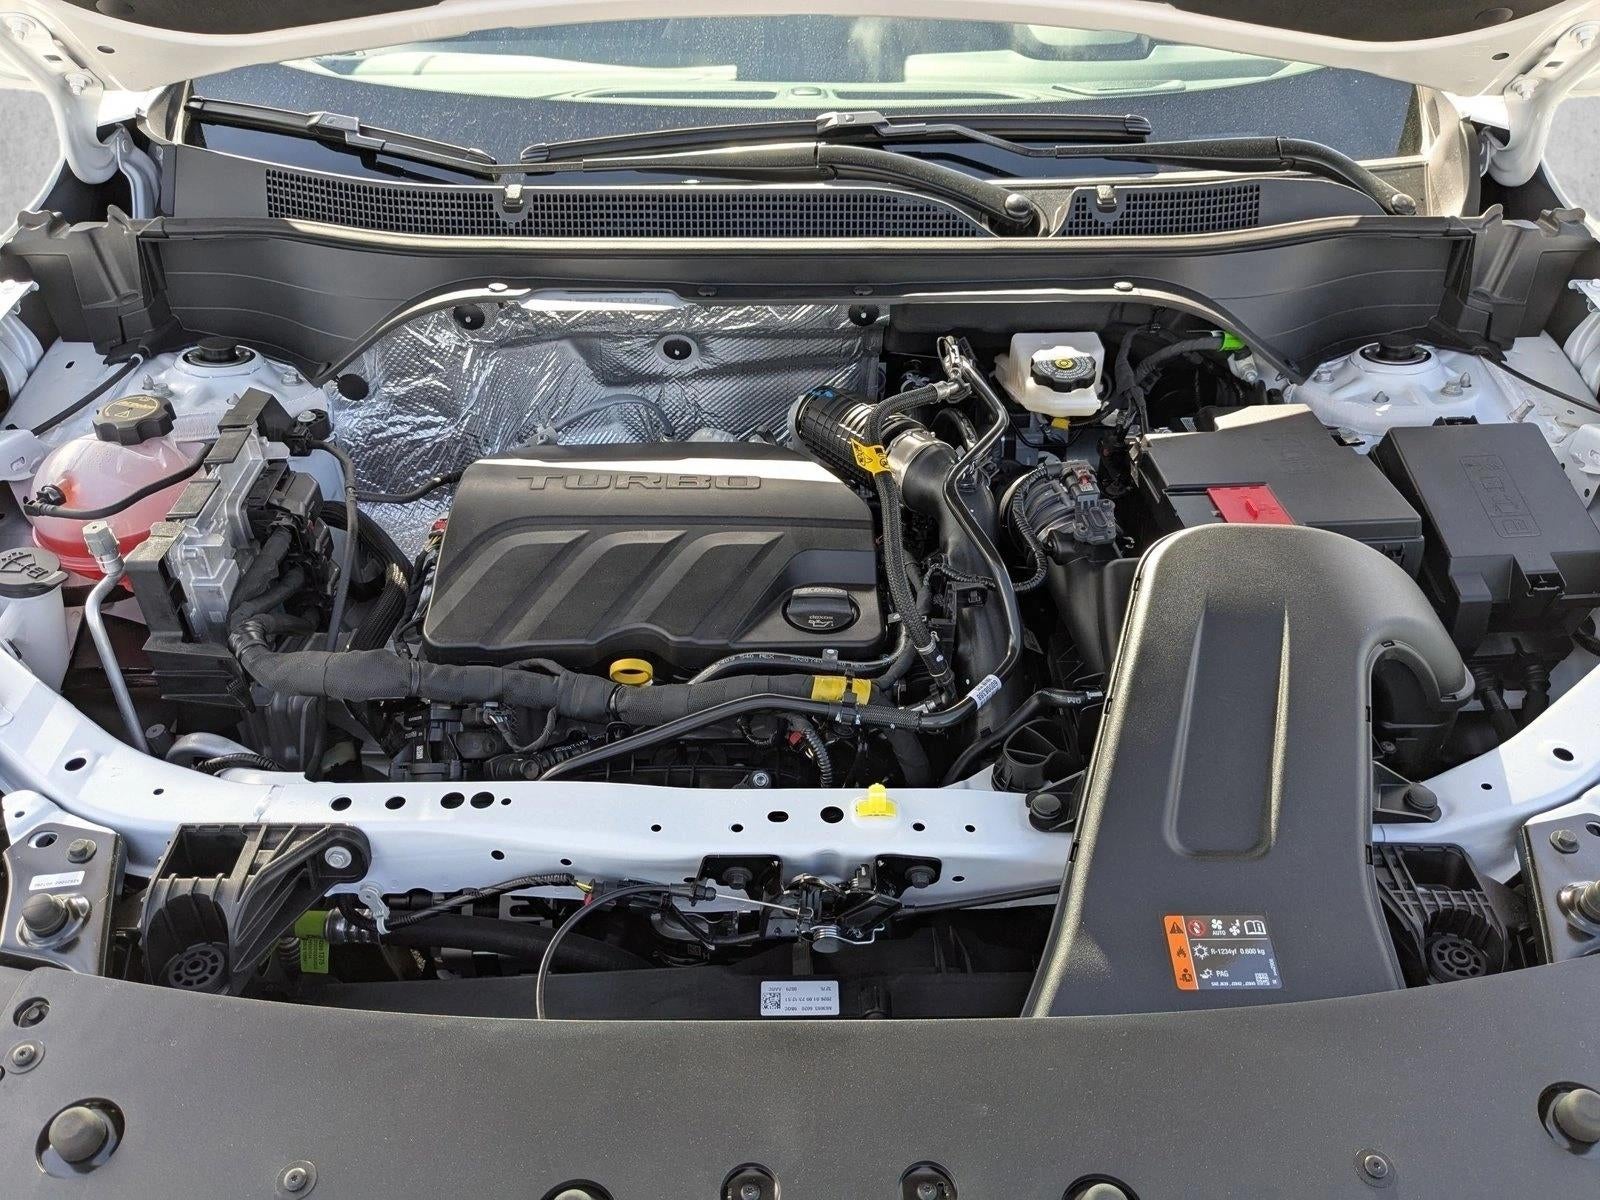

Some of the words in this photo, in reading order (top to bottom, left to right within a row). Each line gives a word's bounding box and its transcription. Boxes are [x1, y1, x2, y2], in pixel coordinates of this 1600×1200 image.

[516, 474, 762, 491] TURBO
[1210, 948, 1237, 956] R-1234yf
[1257, 948, 1266, 956] kg
[1216, 970, 1229, 978] PAG
